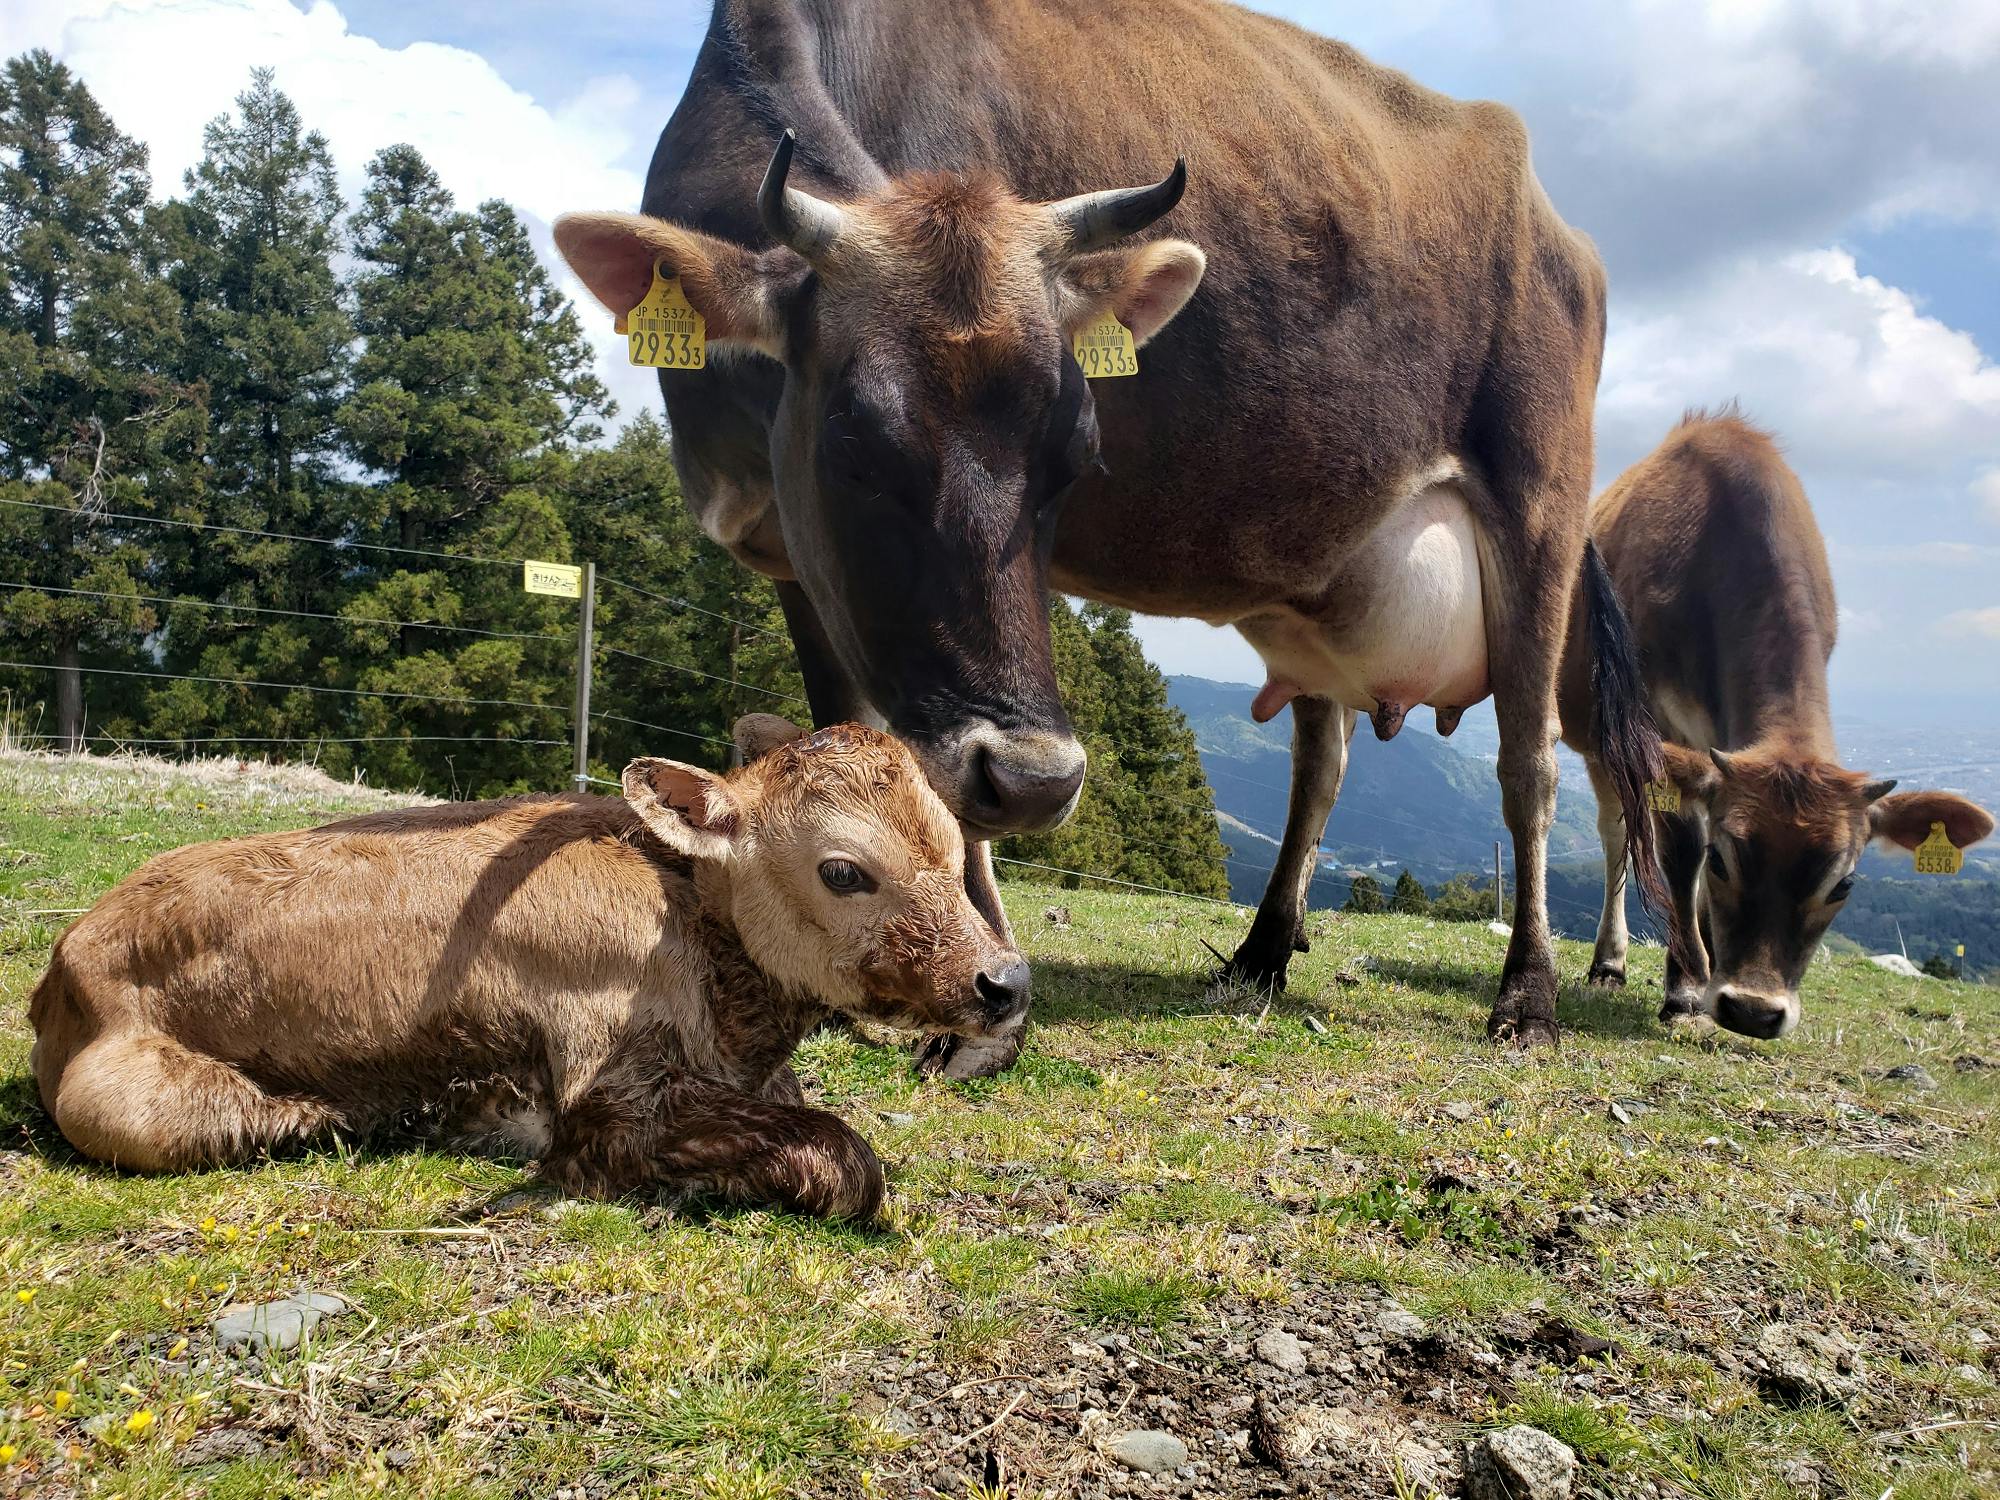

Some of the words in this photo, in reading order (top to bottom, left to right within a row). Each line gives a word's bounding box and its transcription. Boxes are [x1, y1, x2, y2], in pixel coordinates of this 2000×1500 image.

[636, 306, 648, 317] JP
[654, 308, 695, 319] 15374
[632, 331, 701, 366] 29333
[1077, 346, 1135, 375] 29333
